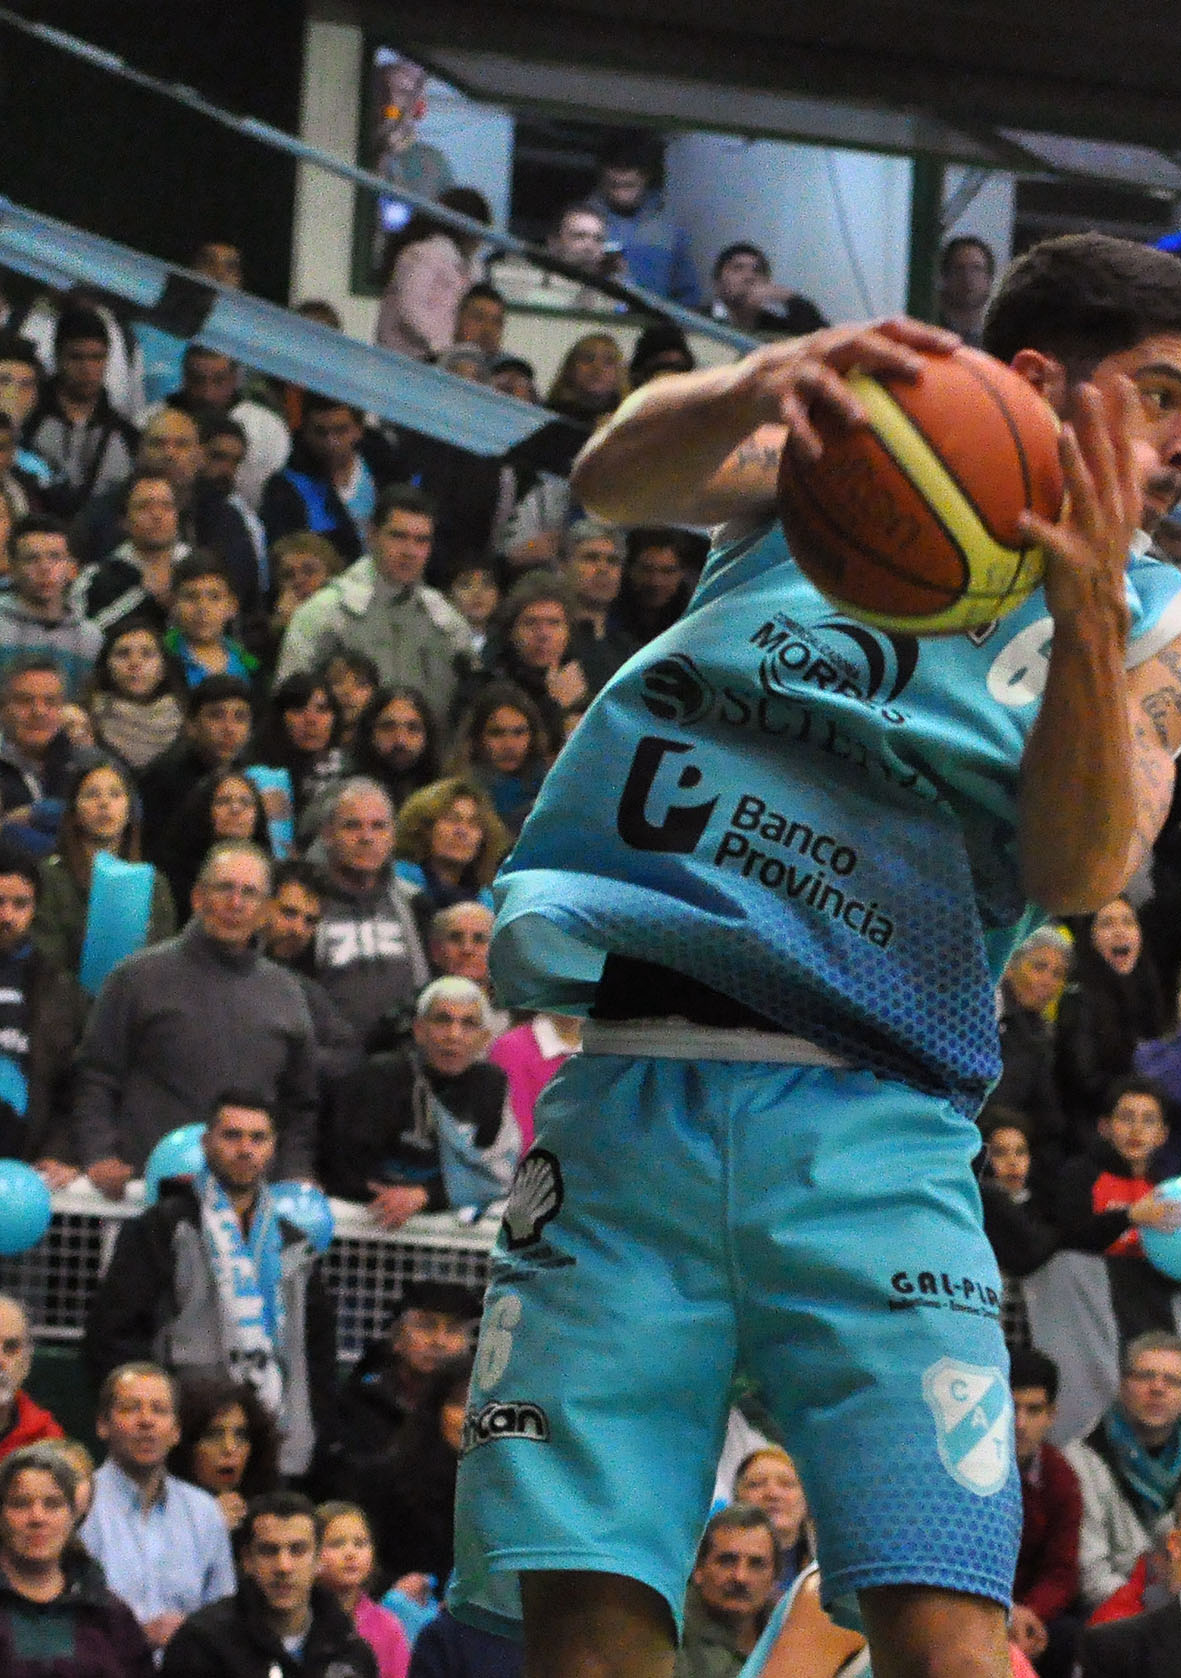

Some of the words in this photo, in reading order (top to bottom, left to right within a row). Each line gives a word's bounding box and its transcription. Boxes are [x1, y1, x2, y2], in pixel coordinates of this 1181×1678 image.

[986, 617, 1056, 708] 6
[730, 794, 858, 876] Banco
[713, 831, 894, 949] Provincia
